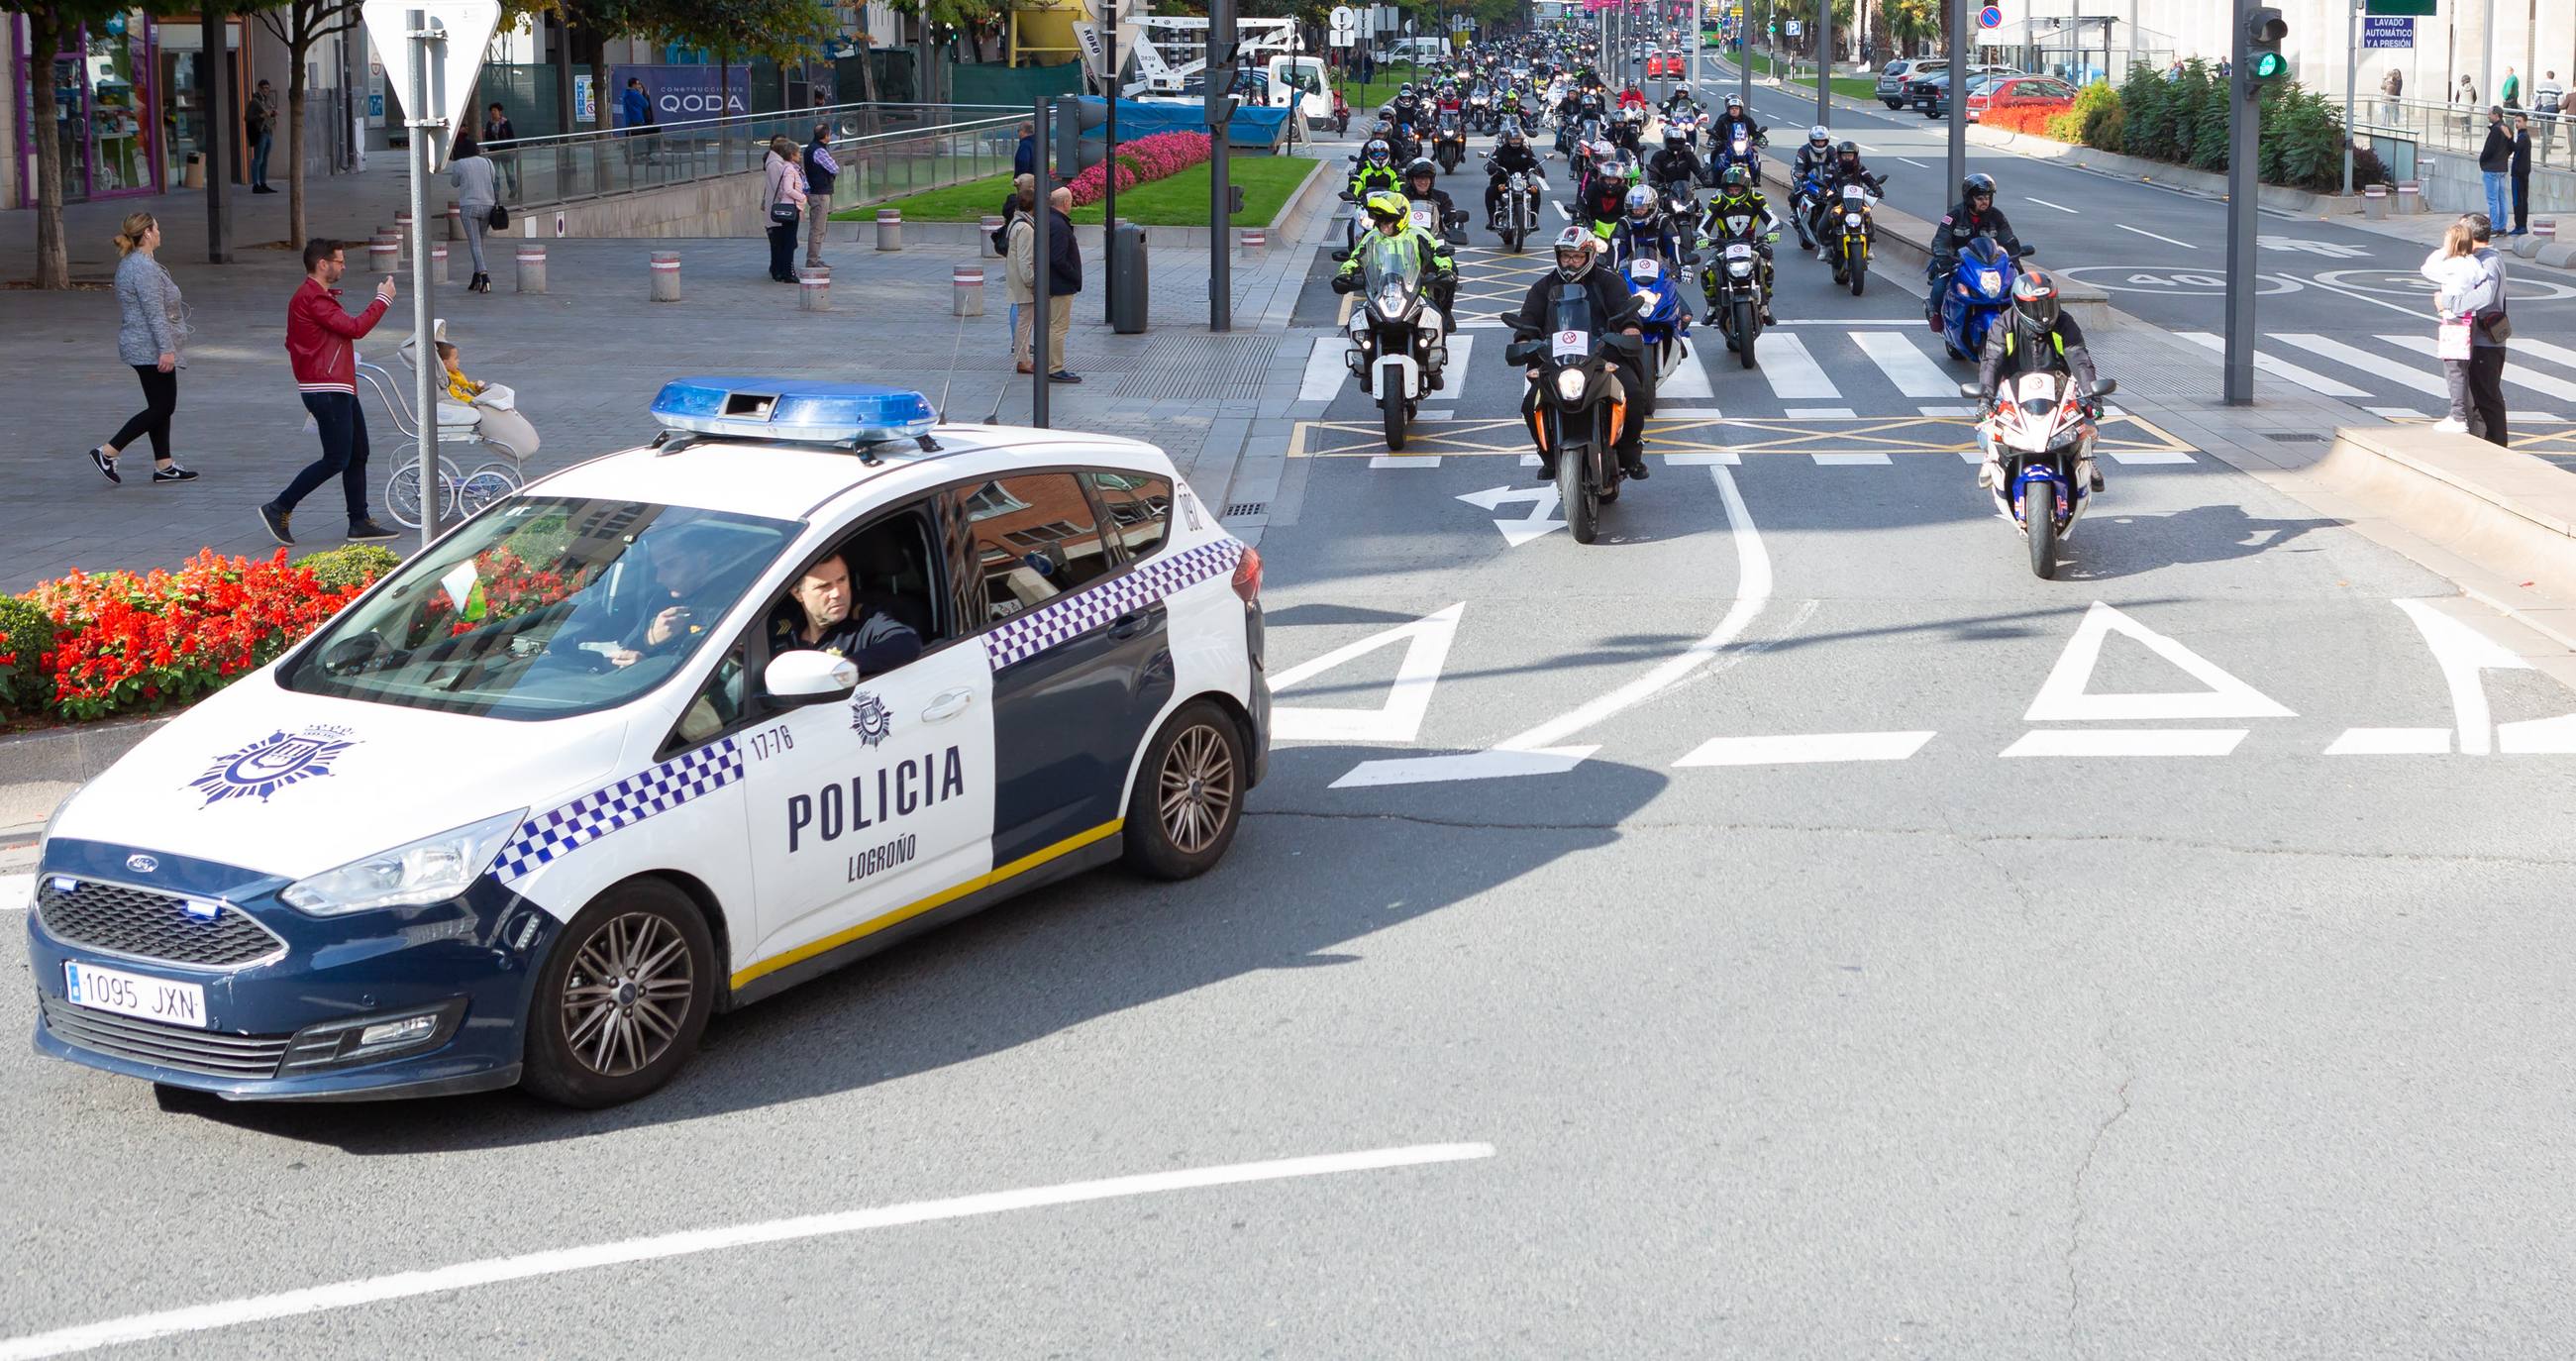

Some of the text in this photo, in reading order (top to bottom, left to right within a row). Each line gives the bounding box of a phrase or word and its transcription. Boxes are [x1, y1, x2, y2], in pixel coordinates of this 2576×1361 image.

[2365, 27, 2413, 38] AUTOMÁTICO
[2374, 18, 2405, 27] LAVADO
[1082, 29, 1101, 54] KOKO
[2366, 38, 2412, 48] Y A PRESIÓN
[660, 94, 745, 113] QODA
[2126, 273, 2227, 287] 40
[750, 723, 794, 762] 17-76
[787, 745, 965, 854] POLICIA
[847, 833, 917, 884] LOGROÑO
[86, 973, 195, 1020] 1095 JXN
